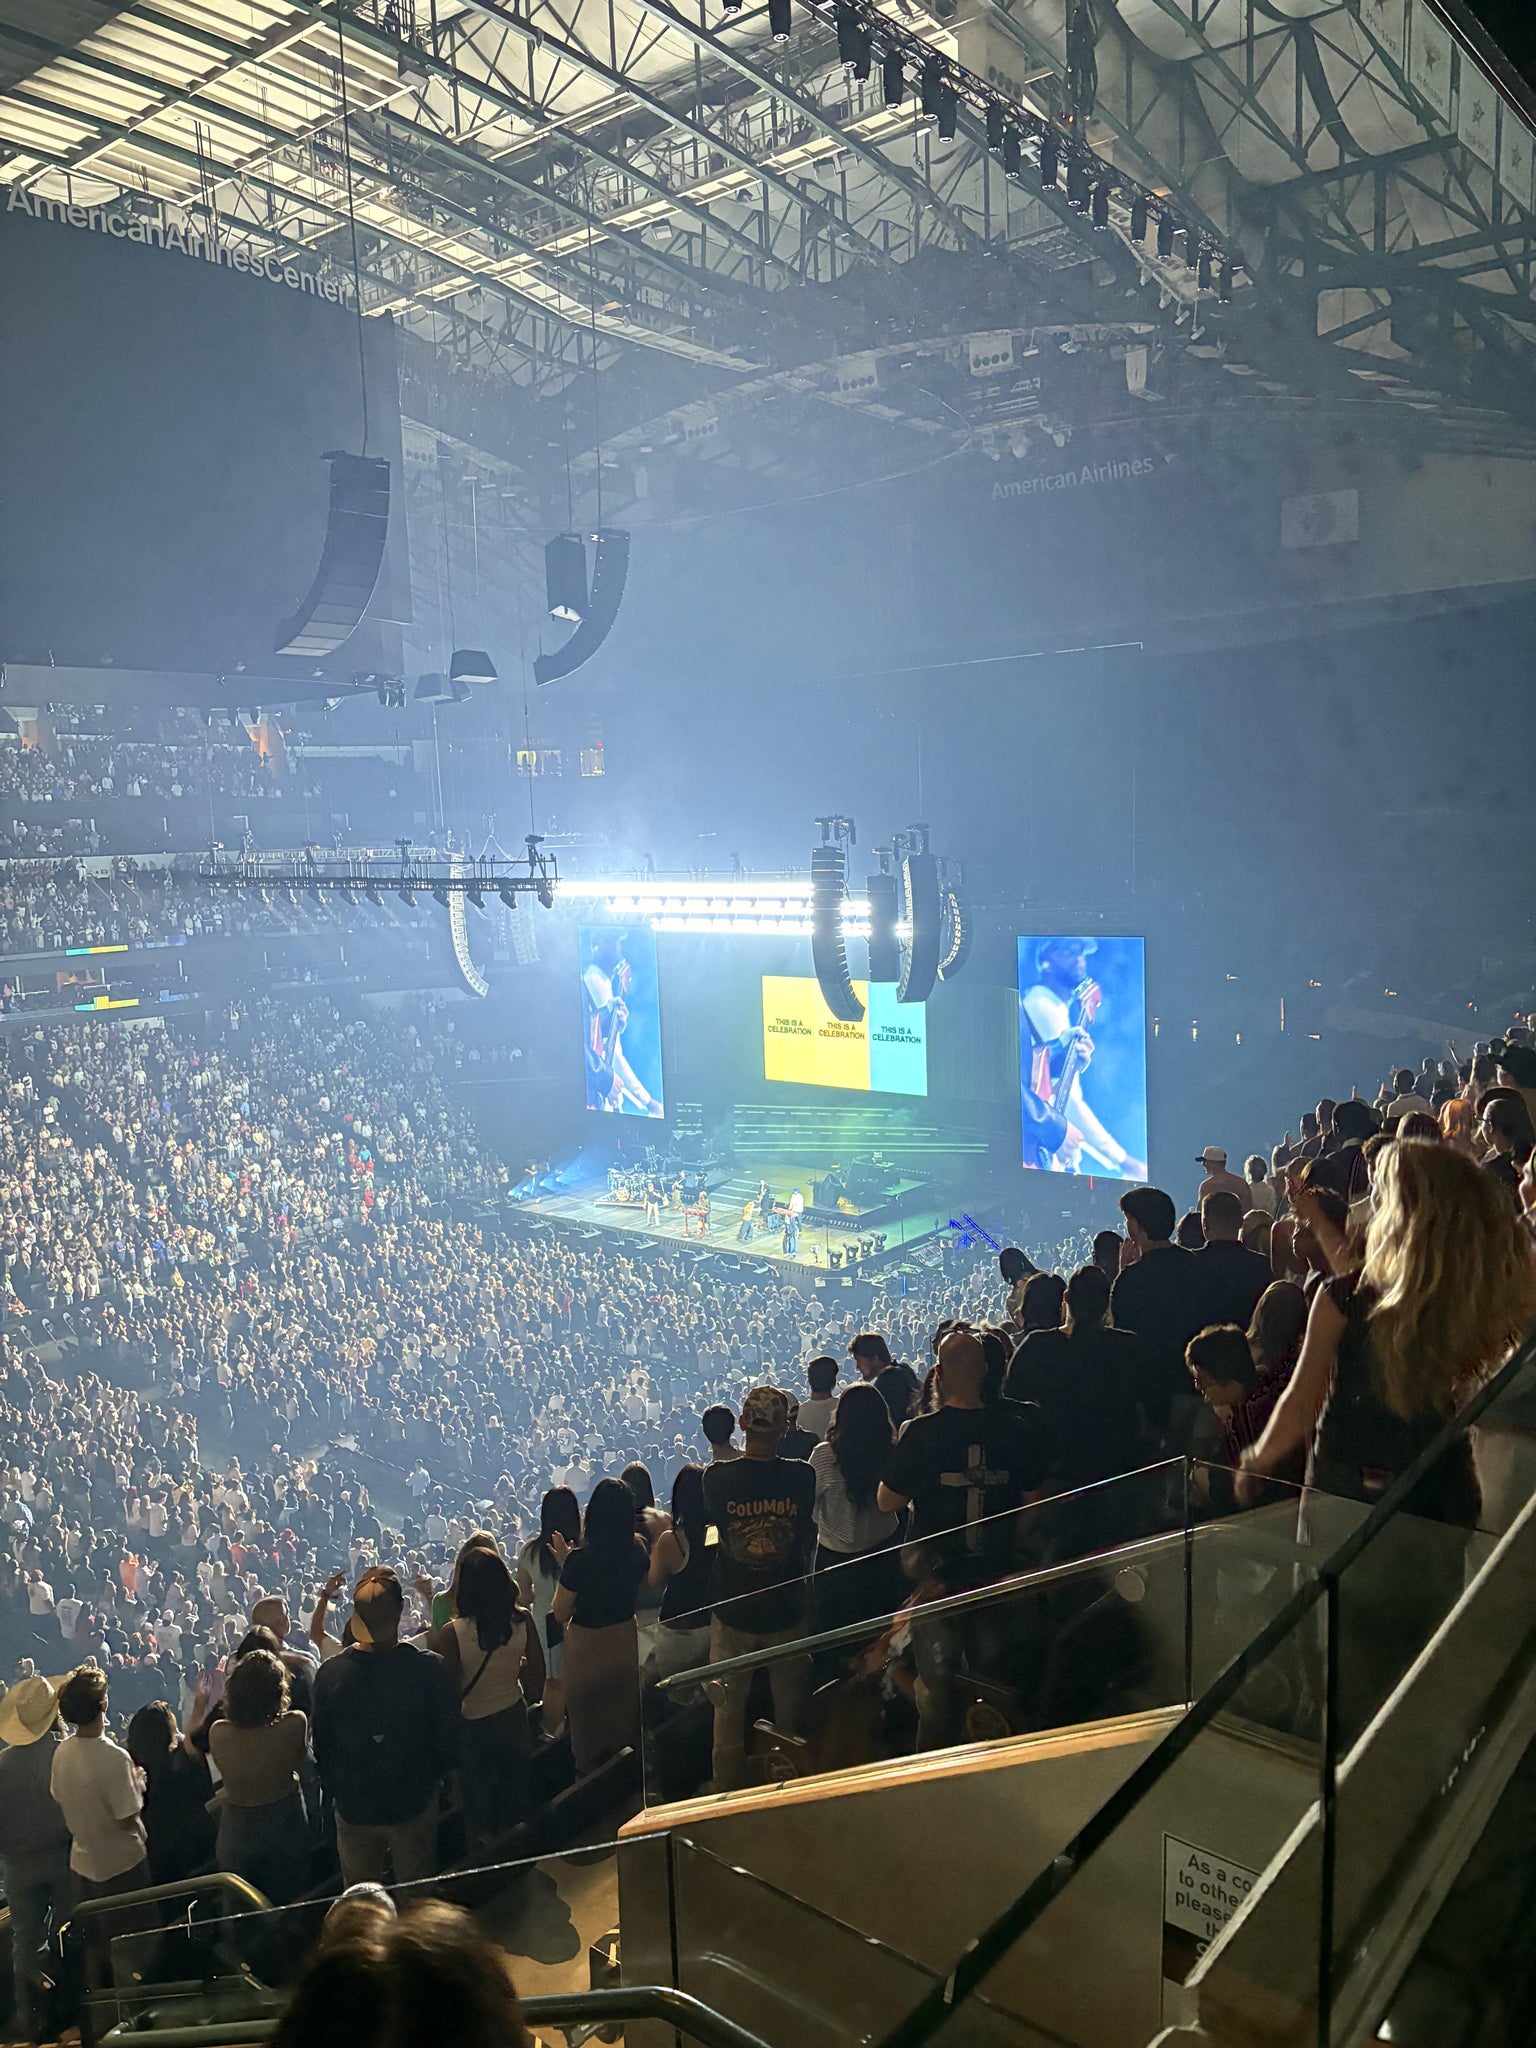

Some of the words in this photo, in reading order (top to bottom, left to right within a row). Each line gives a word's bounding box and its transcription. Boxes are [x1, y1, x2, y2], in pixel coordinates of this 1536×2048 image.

[992, 472, 1077, 500] American
[1080, 457, 1154, 485] Airlines
[776, 1018, 790, 1026] THIS
[827, 1022, 842, 1030] THIS
[768, 1025, 812, 1036] CELEBRATION
[818, 1029, 865, 1040] CELEBRATION
[881, 1026, 897, 1034] THIS
[872, 1033, 921, 1044] CELEBRATION
[726, 1498, 798, 1517] COLUMBIA
[1188, 1853, 1211, 1876] As
[1216, 1868, 1227, 1883] a
[1178, 1870, 1195, 1888] to
[1200, 1882, 1242, 1908] othe
